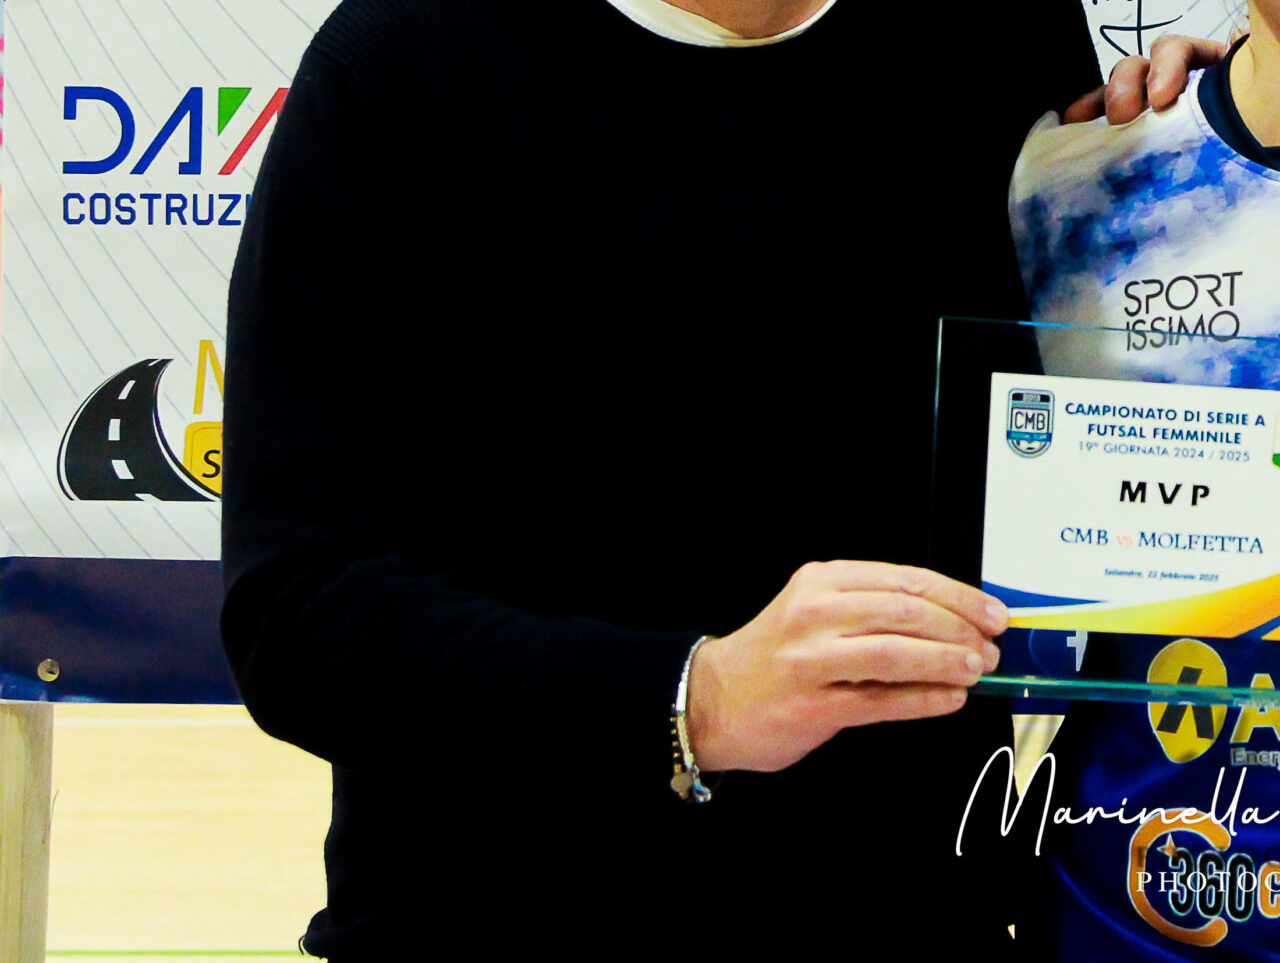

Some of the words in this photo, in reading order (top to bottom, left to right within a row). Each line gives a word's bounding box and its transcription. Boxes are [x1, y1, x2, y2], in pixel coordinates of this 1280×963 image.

[1123, 271, 1243, 317] SPORT
[1125, 310, 1241, 352] ISSIMO
[1015, 411, 1046, 431] CMB
[1065, 402, 1178, 421] CAMPIONATO
[1184, 410, 1200, 422] DI
[1207, 411, 1249, 426] SERIE
[1254, 414, 1266, 426] A
[1087, 423, 1146, 439] FUTSAL
[1153, 427, 1242, 444] FEMMINILE
[1104, 442, 1169, 457] GIORNATA
[1174, 447, 1205, 459] 2024
[1219, 449, 1251, 462] 2025
[1060, 527, 1109, 546] CMB
[1138, 531, 1264, 554] MOLFETTA
